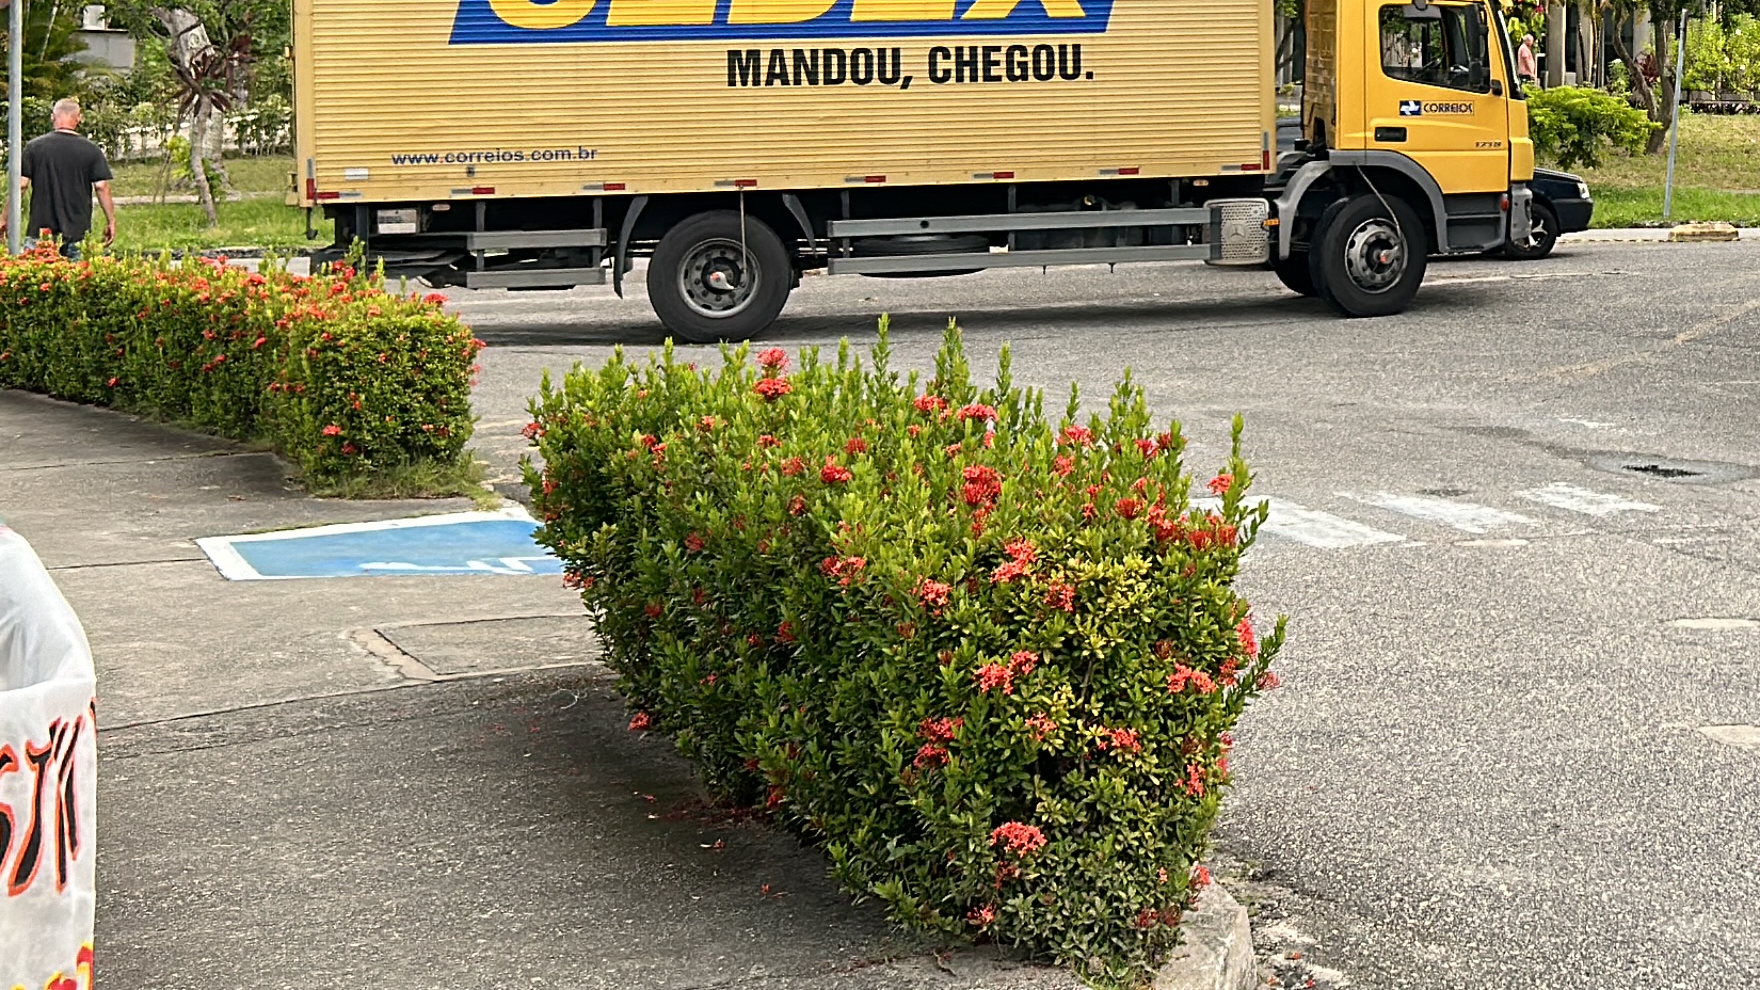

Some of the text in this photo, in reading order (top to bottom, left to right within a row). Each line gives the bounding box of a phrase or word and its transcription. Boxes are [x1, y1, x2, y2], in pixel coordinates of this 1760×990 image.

[727, 44, 1094, 89] MANDOU, CHEGOU.
[391, 146, 598, 165] www.correios.com.br
